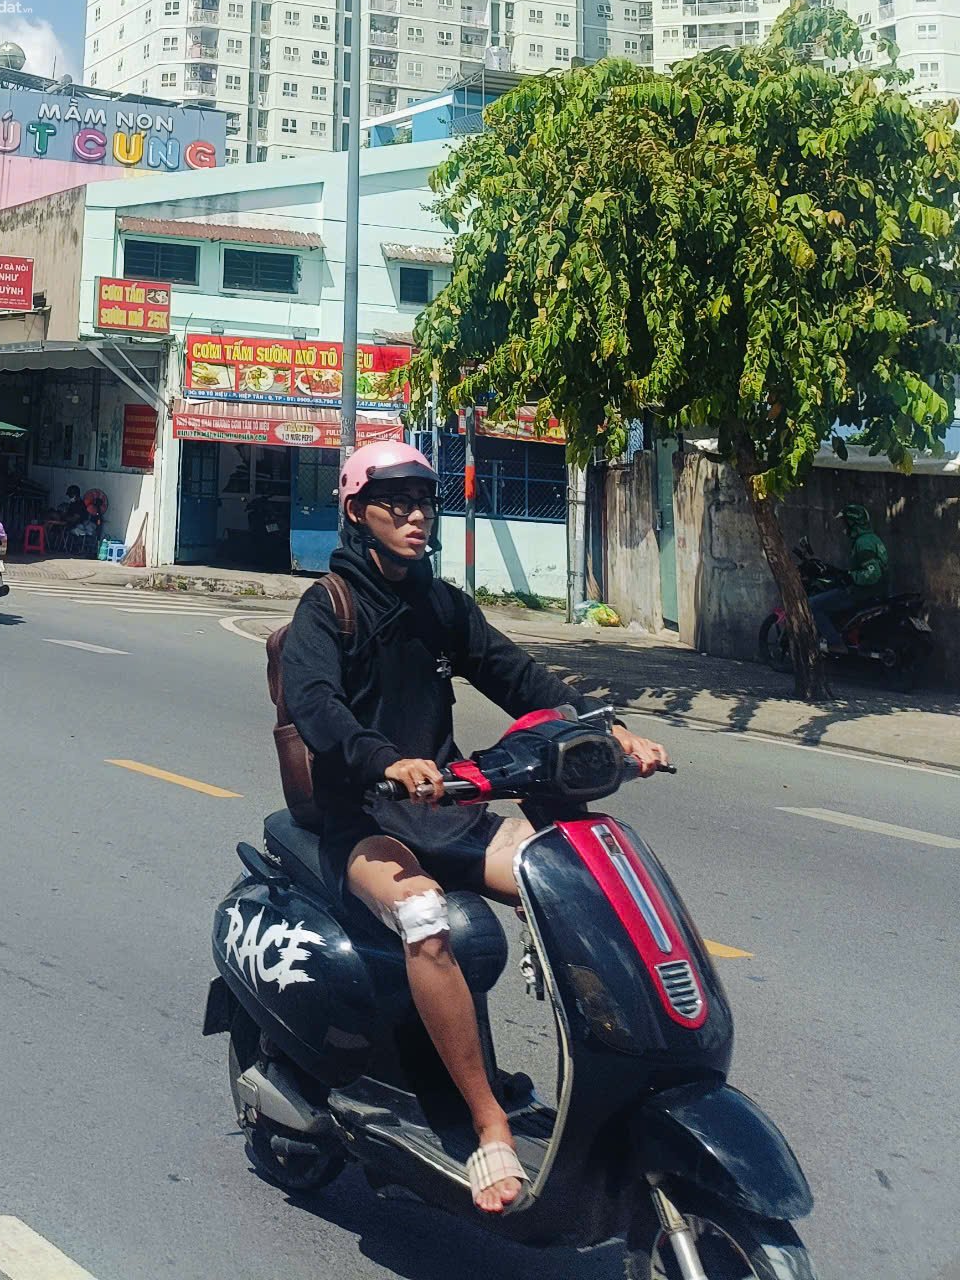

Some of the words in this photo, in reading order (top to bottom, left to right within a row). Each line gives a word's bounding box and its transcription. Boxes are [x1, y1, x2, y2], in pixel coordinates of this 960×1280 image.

[38, 98, 106, 125] MẦM
[116, 111, 173, 132] NON
[73, 127, 216, 169] CƯNG
[4, 262, 14, 271] GÀ
[101, 284, 123, 301] CƠM
[125, 282, 145, 303] TẤM
[147, 310, 169, 329] 25K
[192, 342, 222, 360] CƠM
[224, 340, 254, 362] TẤM
[256, 344, 292, 364] SƯỜN
[320, 348, 338, 367] TÔ
[223, 897, 328, 993] RACE
